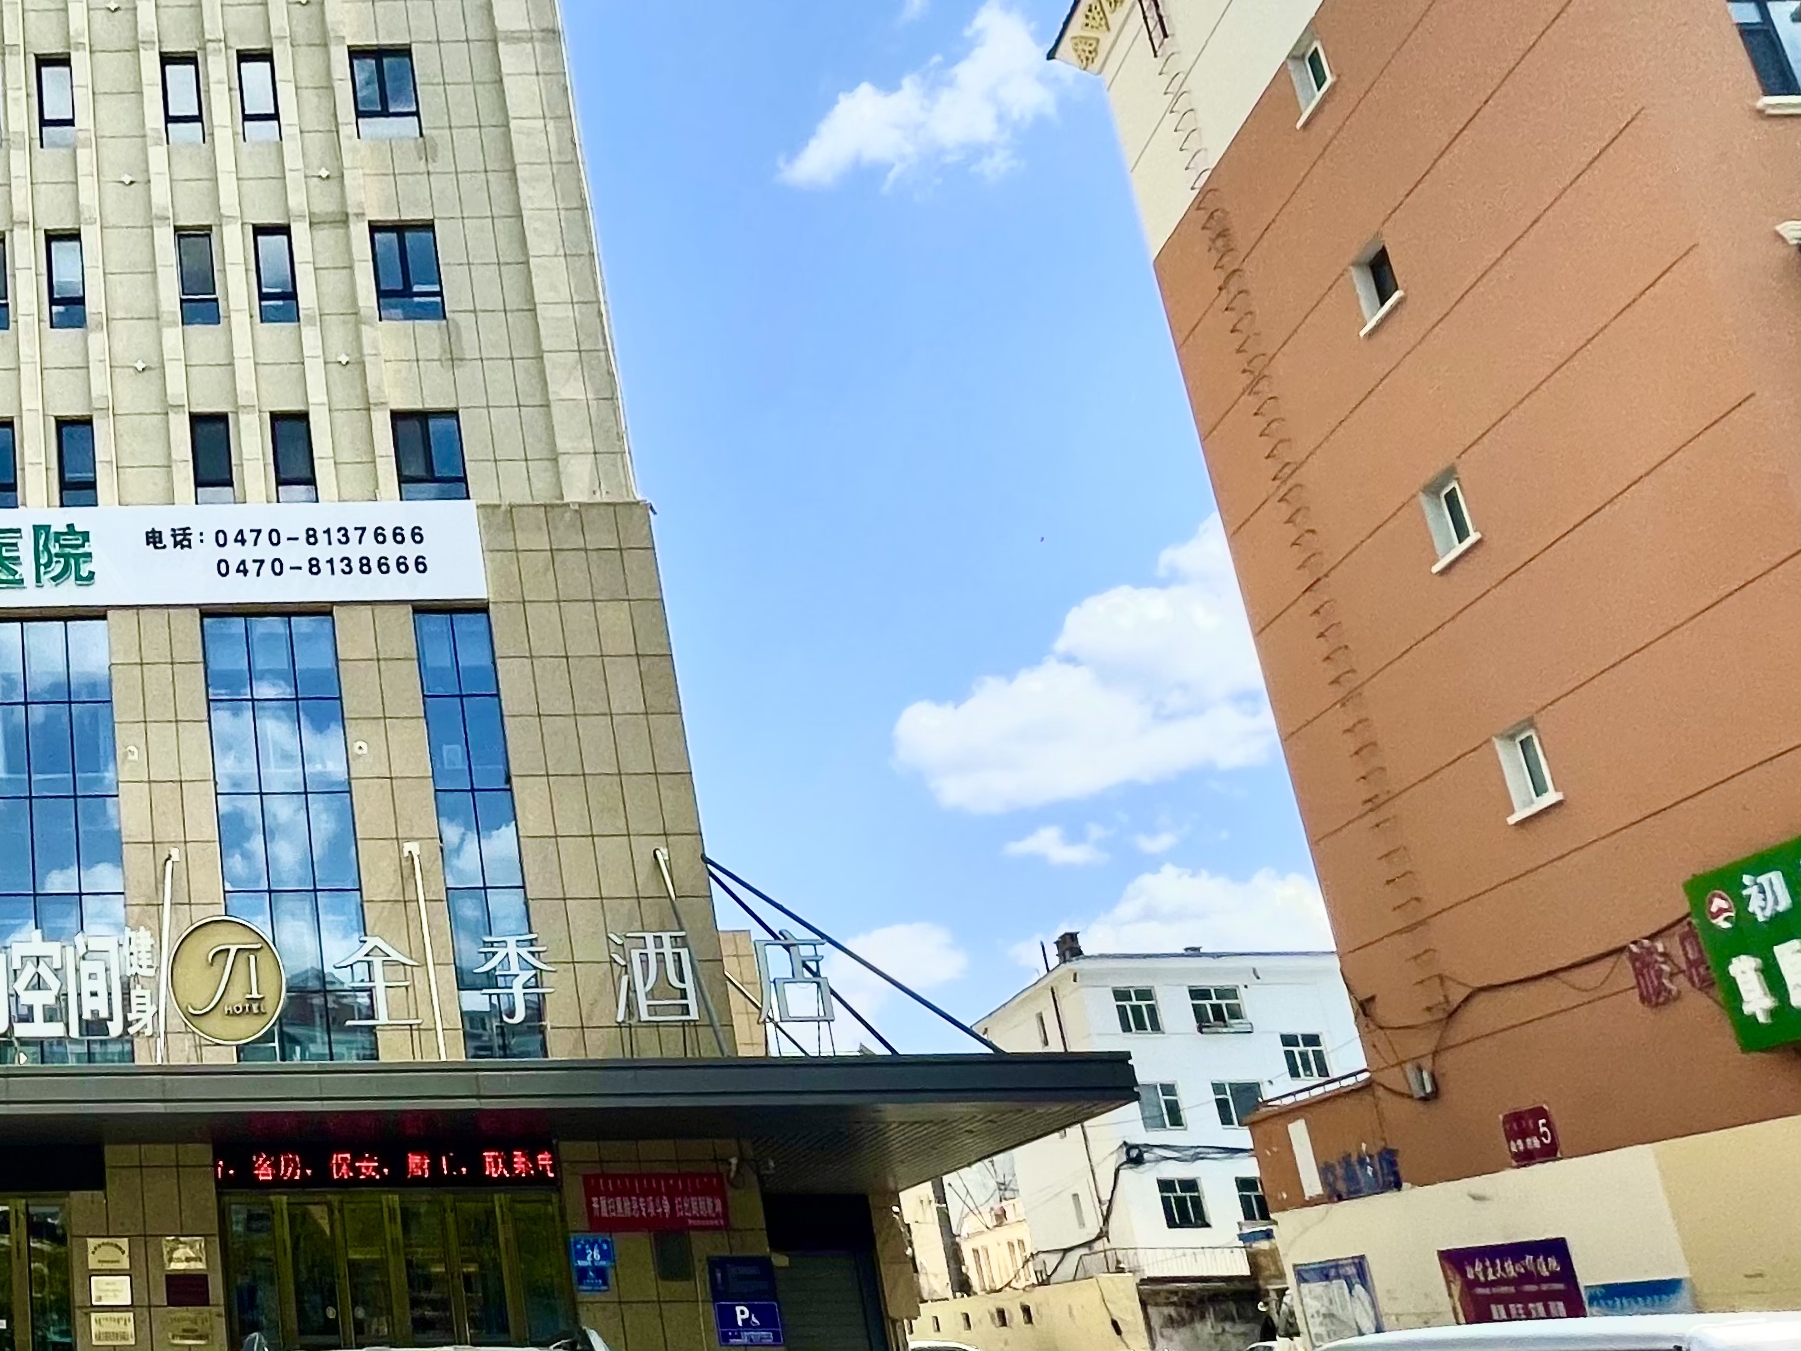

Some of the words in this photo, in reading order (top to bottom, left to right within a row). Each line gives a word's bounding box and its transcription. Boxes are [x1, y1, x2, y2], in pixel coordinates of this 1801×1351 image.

[216, 555, 429, 578] 0470-8138666
[122, 925, 158, 1038] 健身
[333, 928, 836, 1027] 全季酒店
[223, 1003, 268, 1017] HOTEL
[1538, 1119, 1552, 1145] 5
[735, 1305, 750, 1328] P
